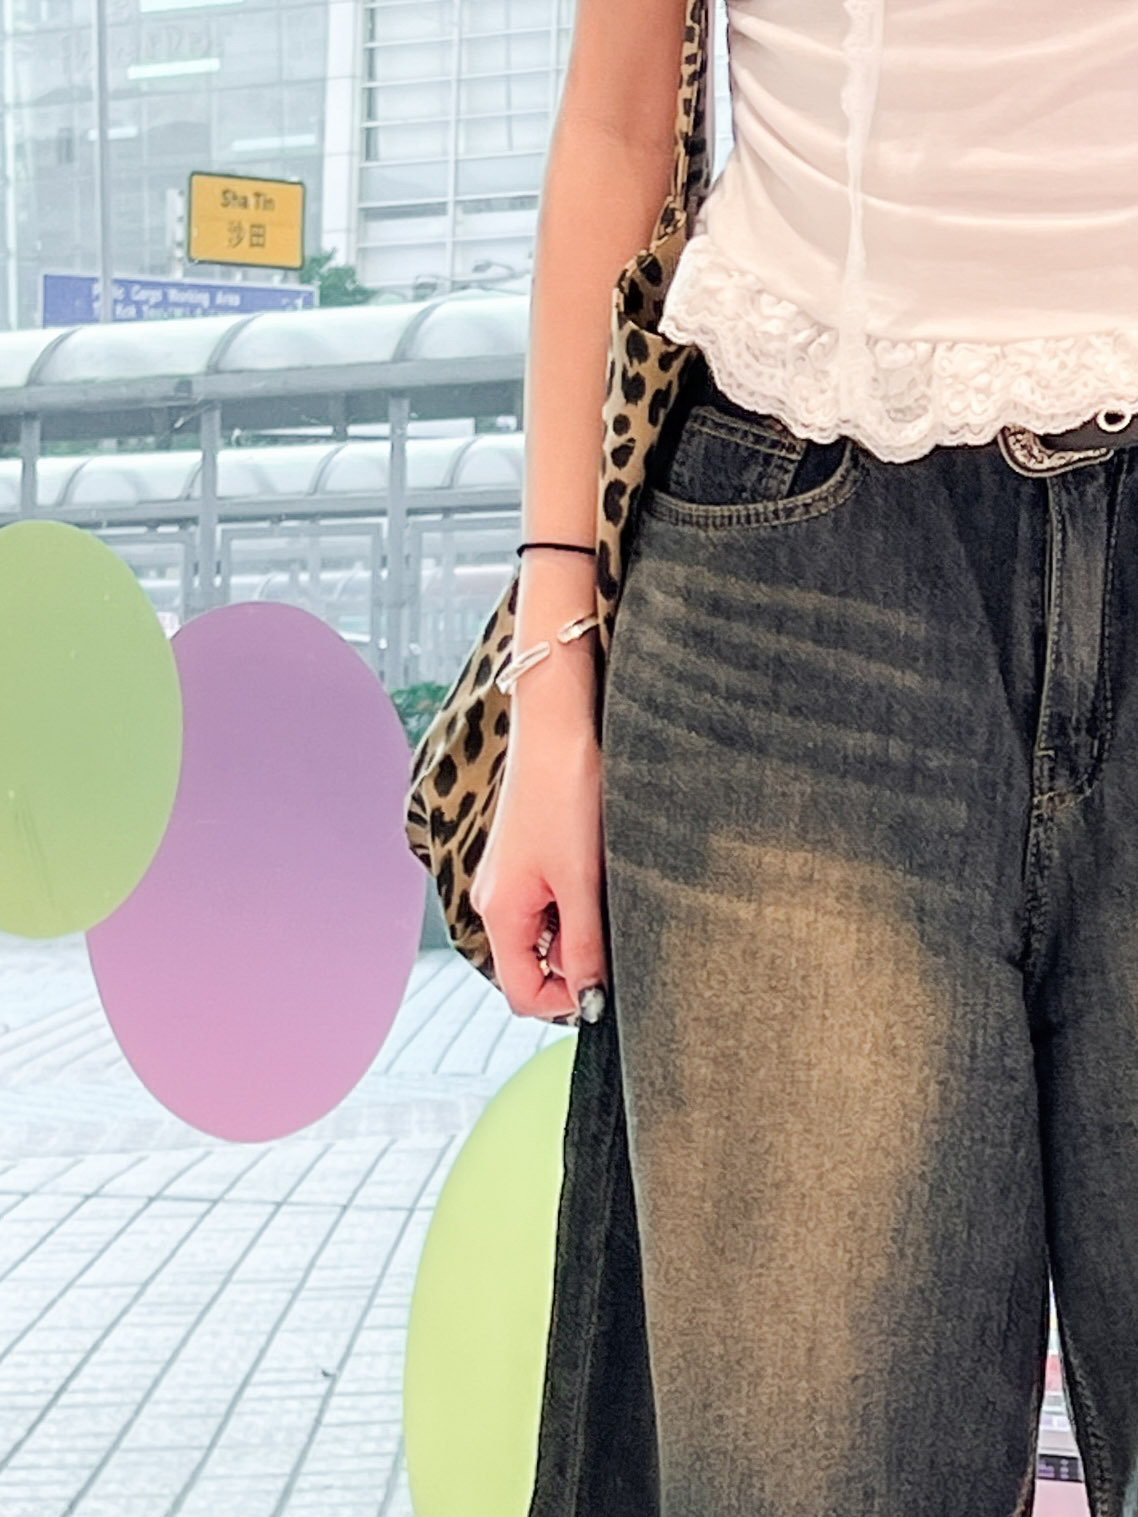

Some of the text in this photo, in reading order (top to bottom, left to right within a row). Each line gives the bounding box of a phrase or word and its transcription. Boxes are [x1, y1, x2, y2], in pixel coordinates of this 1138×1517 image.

[220, 188, 276, 211] Sha Tin
[226, 220, 266, 248] 沙田
